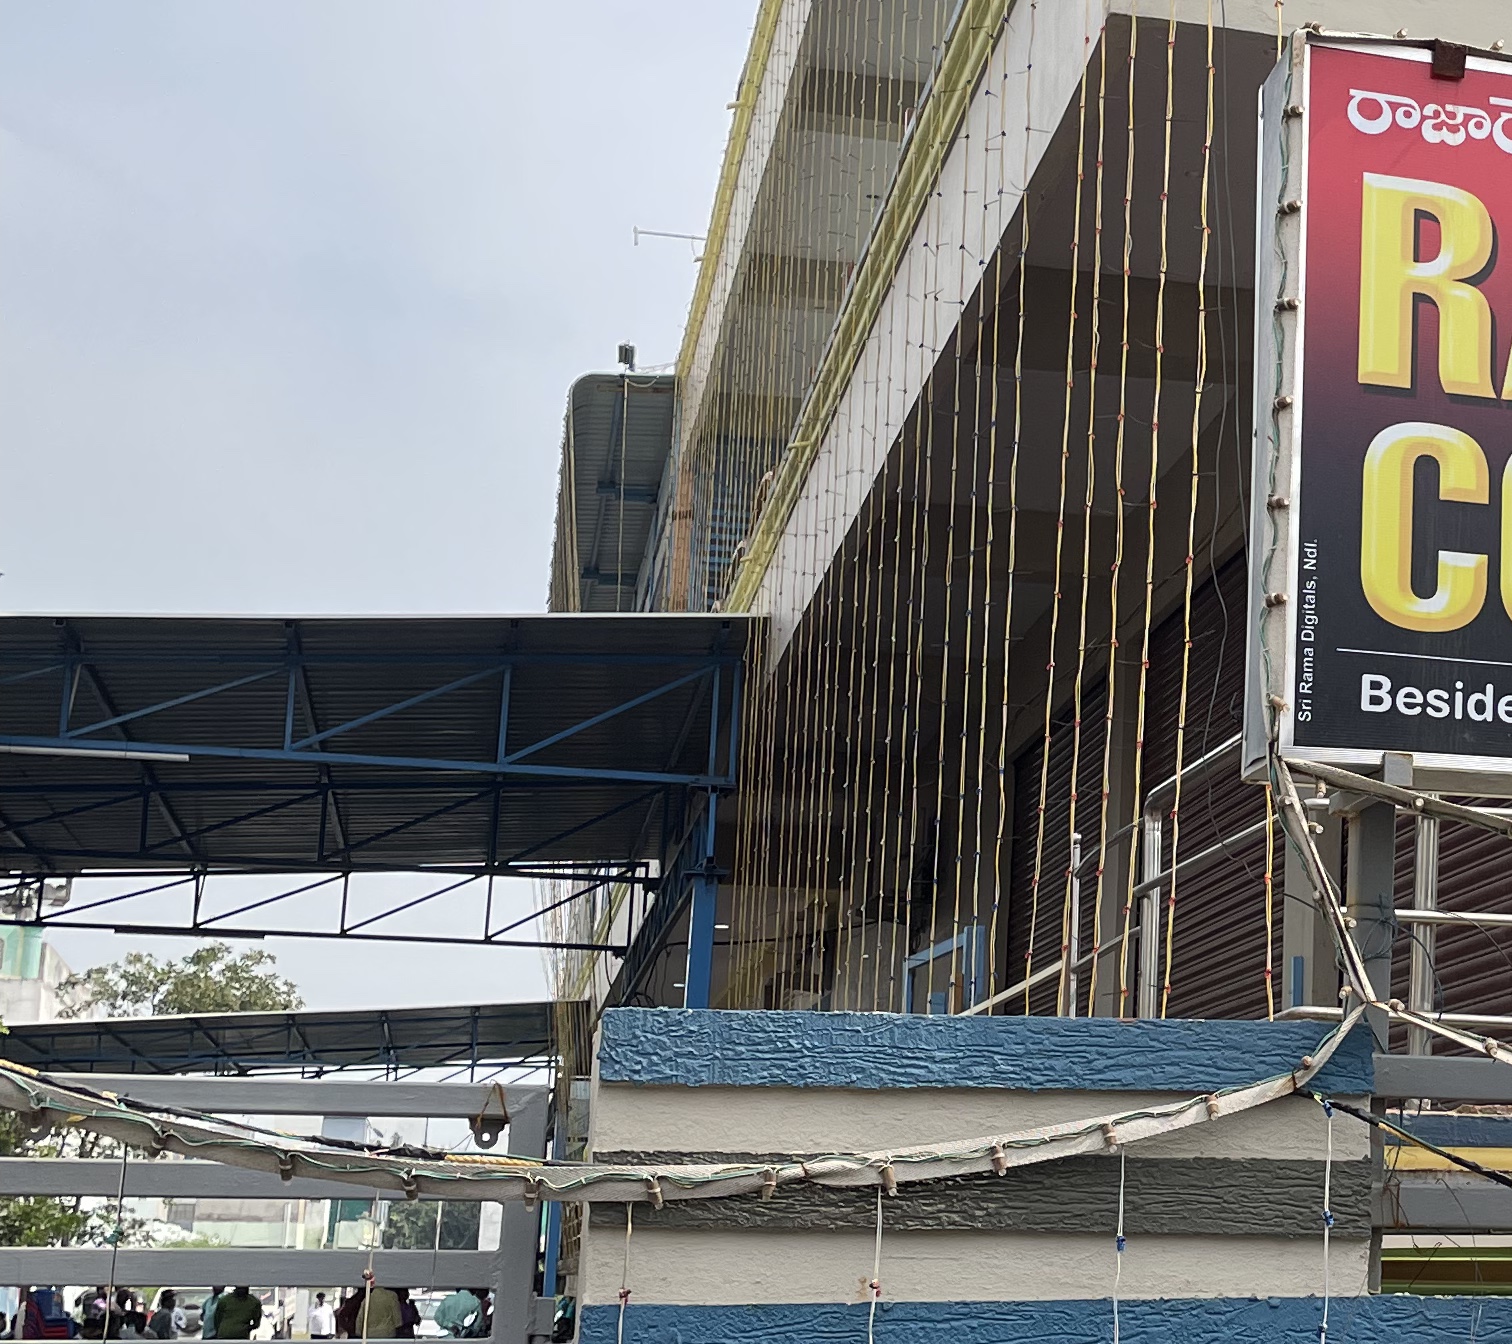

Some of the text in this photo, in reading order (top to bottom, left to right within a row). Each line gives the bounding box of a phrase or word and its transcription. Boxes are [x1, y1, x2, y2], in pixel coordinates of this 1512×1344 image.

[1301, 574, 1319, 642] Digitals,
[1299, 646, 1314, 693] Rama
[1298, 698, 1312, 723] Sri
